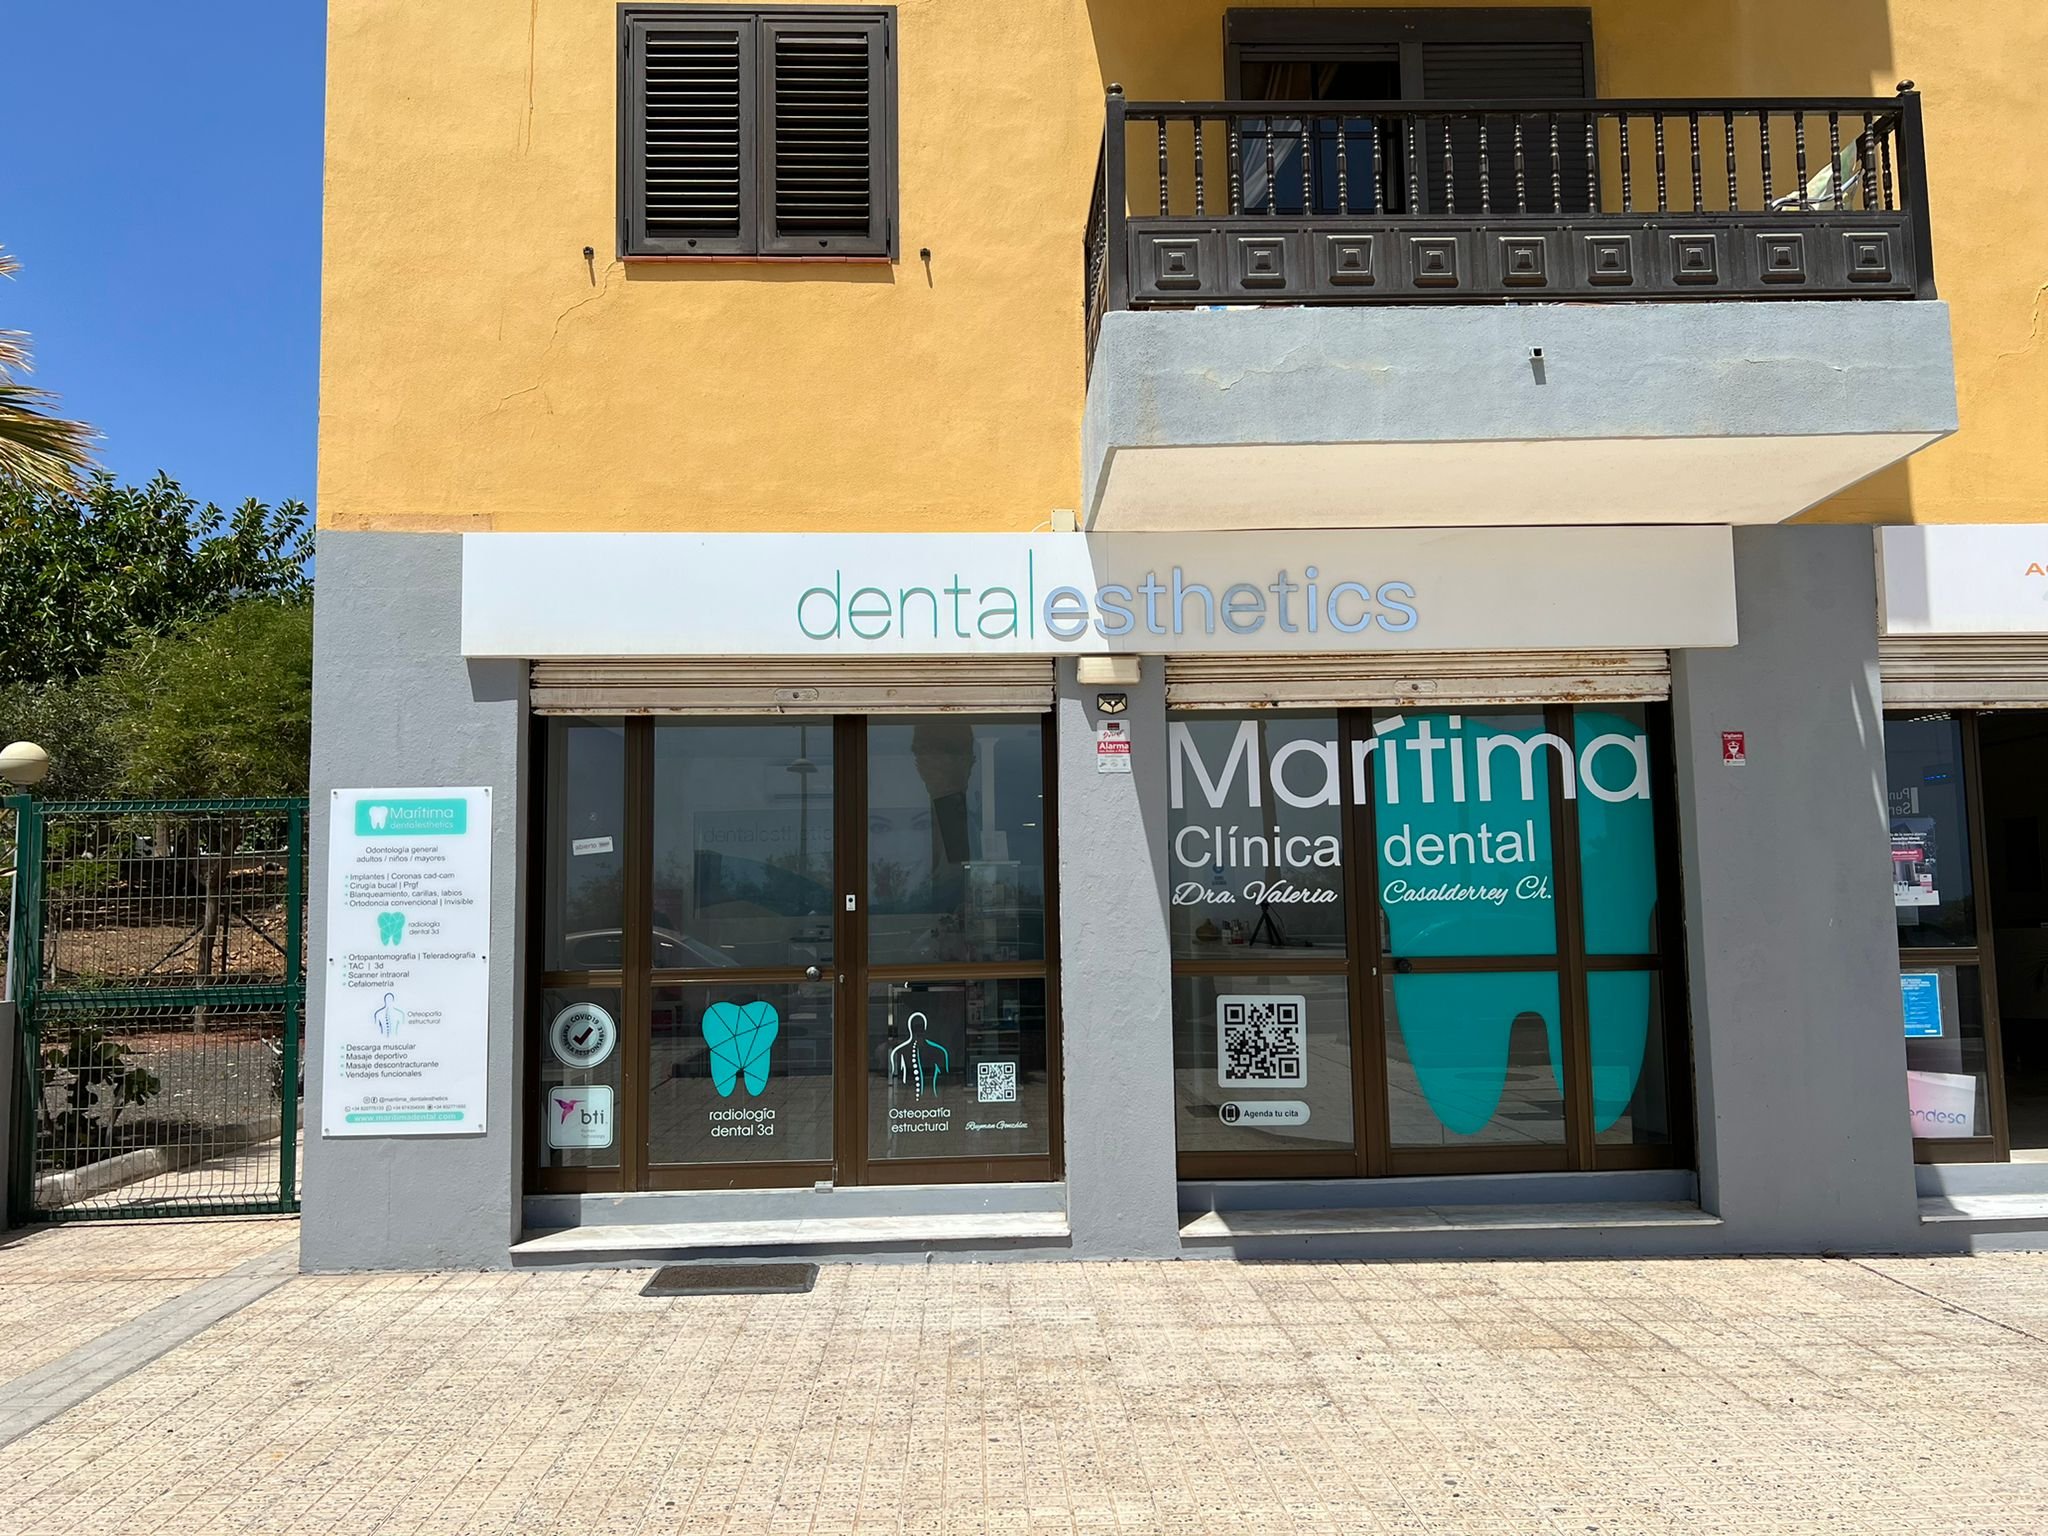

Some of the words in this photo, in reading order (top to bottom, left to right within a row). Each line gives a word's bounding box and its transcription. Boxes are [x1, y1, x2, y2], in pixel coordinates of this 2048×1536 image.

[797, 549, 1418, 640] dentalesthetics
[1099, 742, 1129, 750] Alarma
[1168, 714, 1652, 809] Marítima
[390, 806, 454, 820] Marítima
[390, 821, 454, 830] dentalesthetics
[1174, 825, 1341, 868] Clínica
[1384, 819, 1536, 867] dental
[411, 846, 438, 854] general
[356, 855, 383, 863] adultos
[414, 855, 446, 863] mayores
[349, 873, 385, 881] Implantes
[423, 872, 455, 880] cad-cam
[377, 881, 398, 889] bucal
[403, 881, 419, 889] Prgf
[441, 889, 463, 897] labios
[1172, 881, 1236, 906] Dra.
[1243, 880, 1339, 906] Valeria
[1383, 880, 1508, 906] Casalderrey
[1515, 875, 1552, 900] Ch.
[349, 899, 389, 907] Ortodoncia
[390, 899, 438, 907] convencional
[346, 1044, 381, 1052] Descarga
[383, 1043, 416, 1051] muscular
[346, 1053, 373, 1061] Masaje
[374, 1052, 408, 1061] deportivo
[346, 1062, 373, 1070] Masaje
[374, 1061, 439, 1069] descontracturante
[346, 1071, 379, 1079] Vendajes
[381, 1070, 422, 1078] funcionales
[580, 1109, 605, 1125] bti
[709, 1107, 776, 1122] radiología
[888, 1107, 951, 1120] Osteopatía
[1244, 1110, 1273, 1119] Agenda
[1284, 1109, 1299, 1117] cita
[711, 1124, 754, 1137] dental
[756, 1123, 774, 1136] 3d
[891, 1121, 949, 1133] estructural
